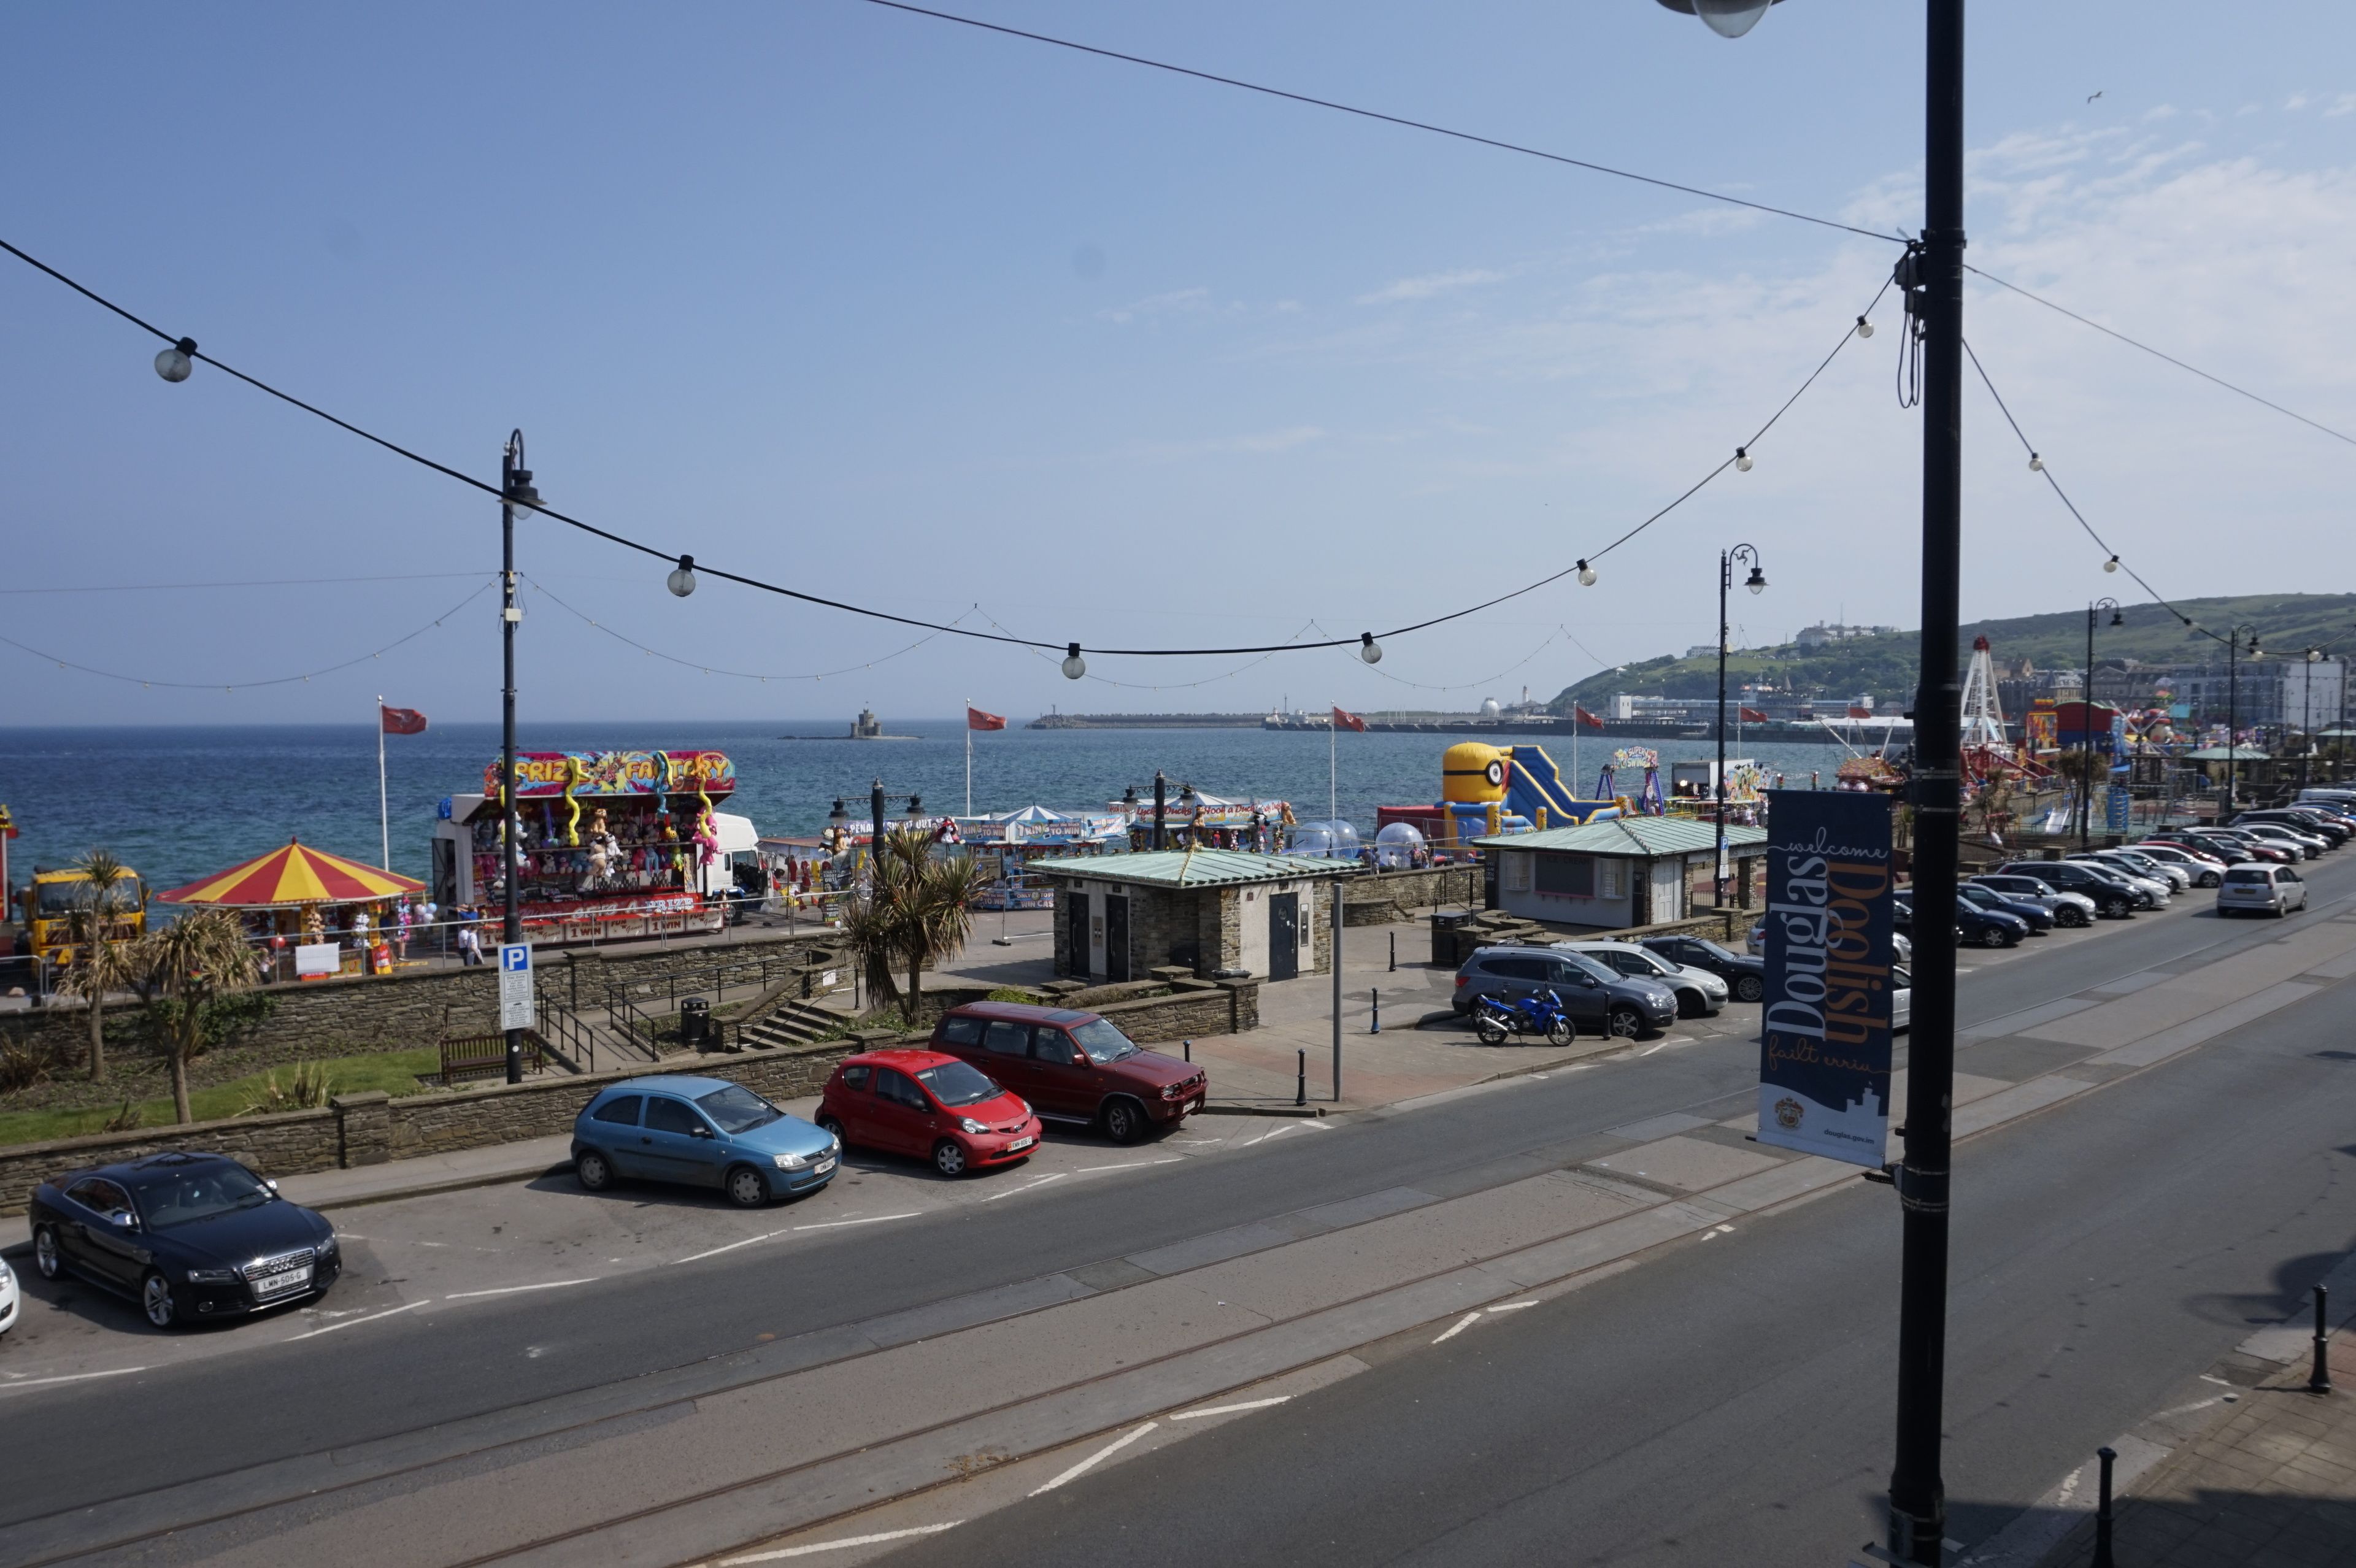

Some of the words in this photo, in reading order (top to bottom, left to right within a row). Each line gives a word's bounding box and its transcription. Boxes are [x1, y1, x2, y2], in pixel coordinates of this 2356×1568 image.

[515, 759, 590, 783] PRIZE
[625, 758, 730, 780] FATORY
[1627, 758, 1646, 767] SWING
[1137, 806, 1156, 817] Luck
[850, 822, 885, 833] PENA
[916, 819, 931, 829] OUT
[963, 824, 982, 834] RING
[1017, 824, 1025, 836] 1
[1025, 824, 1049, 835] RING
[1722, 838, 1728, 849] P
[1768, 826, 1888, 859] welcome
[625, 901, 639, 913] A
[645, 897, 694, 912] PRIZE
[571, 928, 578, 937] 1
[580, 928, 601, 936] WIN
[652, 922, 659, 931] 1
[1766, 856, 1845, 1042] Douglas
[1824, 858, 1888, 1043] Doolish
[508, 948, 525, 970] P
[1769, 1034, 1819, 1071] failt
[1824, 1129, 1874, 1145] douglas.gov.im
[263, 1271, 301, 1289] LMN-505-G
